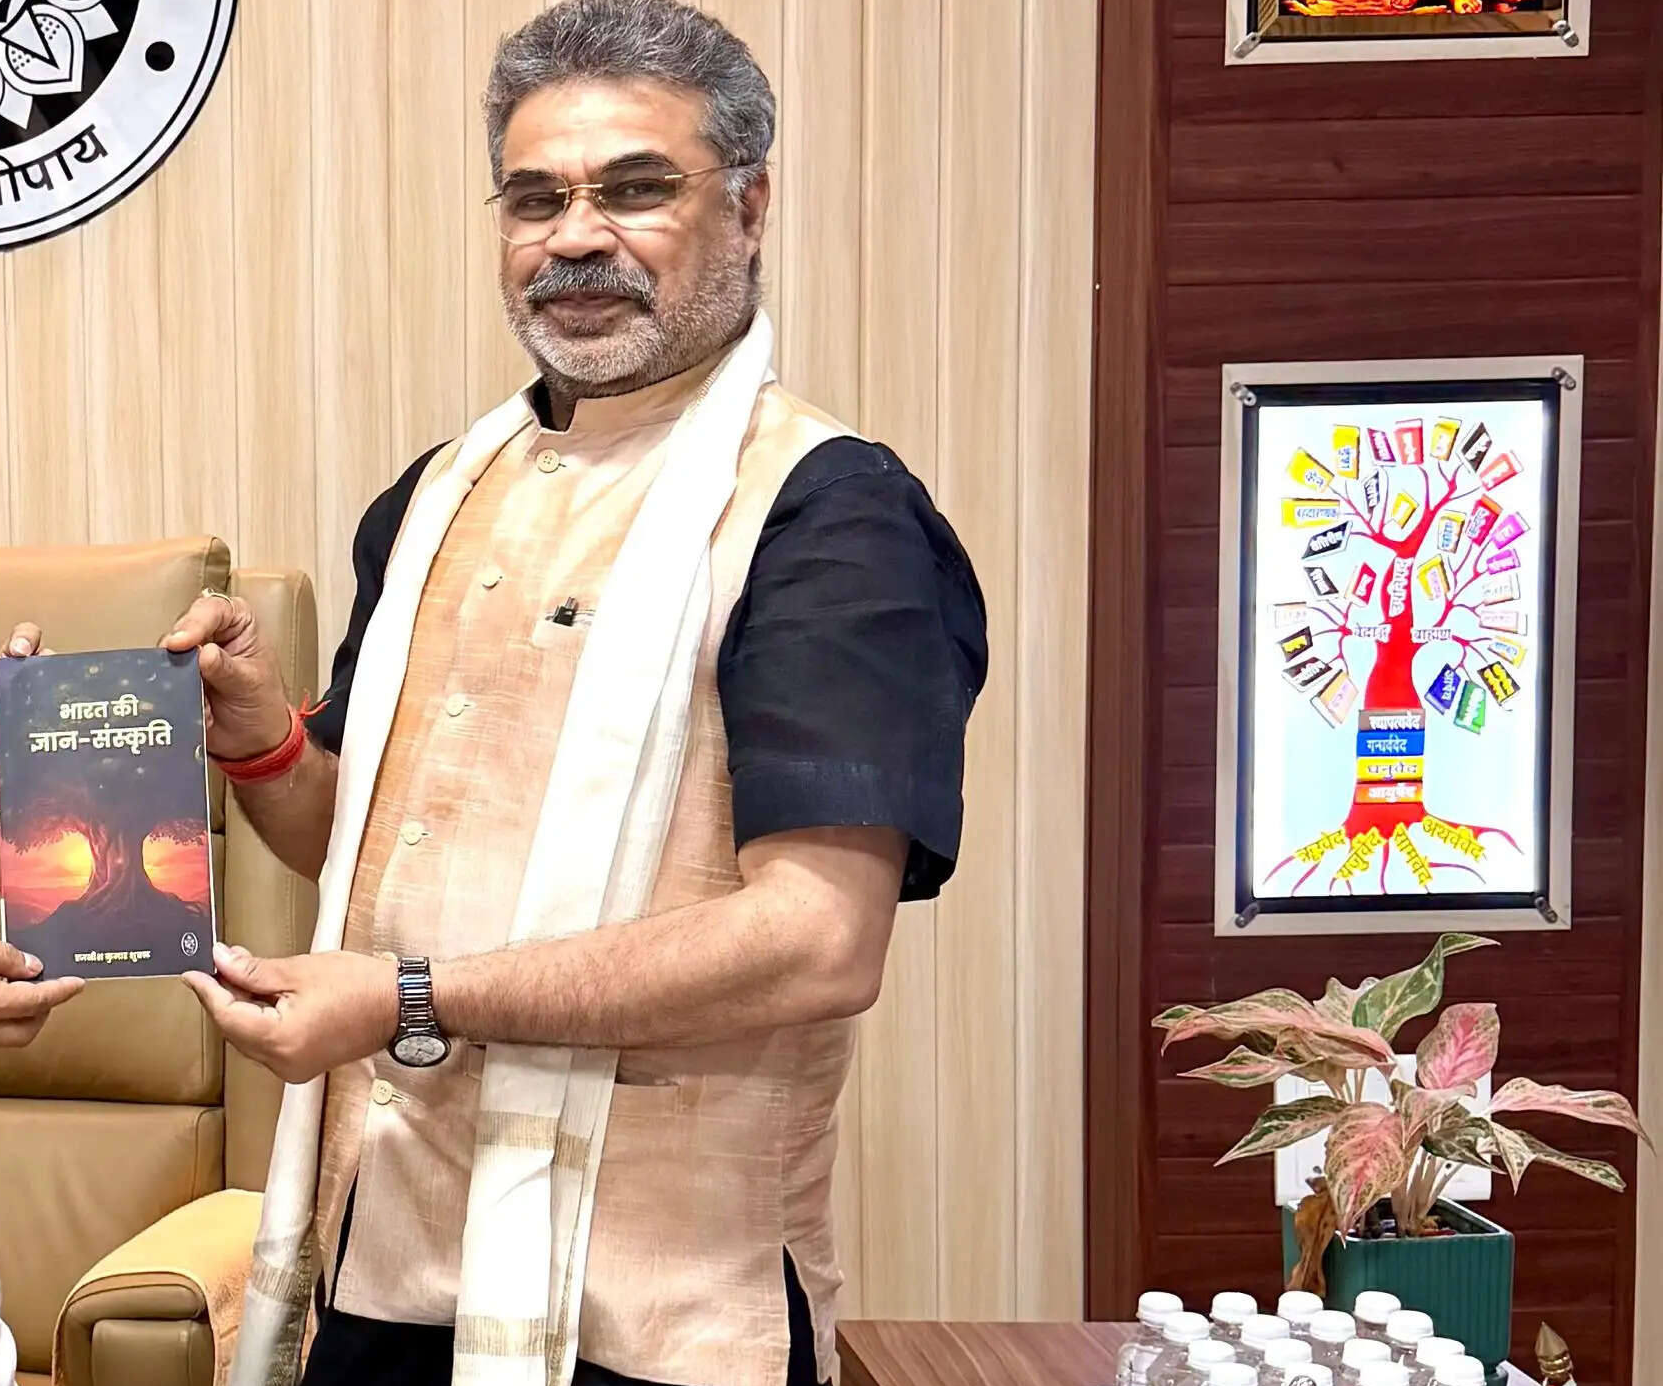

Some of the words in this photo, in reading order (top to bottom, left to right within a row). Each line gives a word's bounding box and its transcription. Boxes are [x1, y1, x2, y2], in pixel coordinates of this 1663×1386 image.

[59, 700, 109, 721] भारत
[110, 693, 140, 718] की
[29, 719, 173, 755] ज्ञान-संस्कृति
